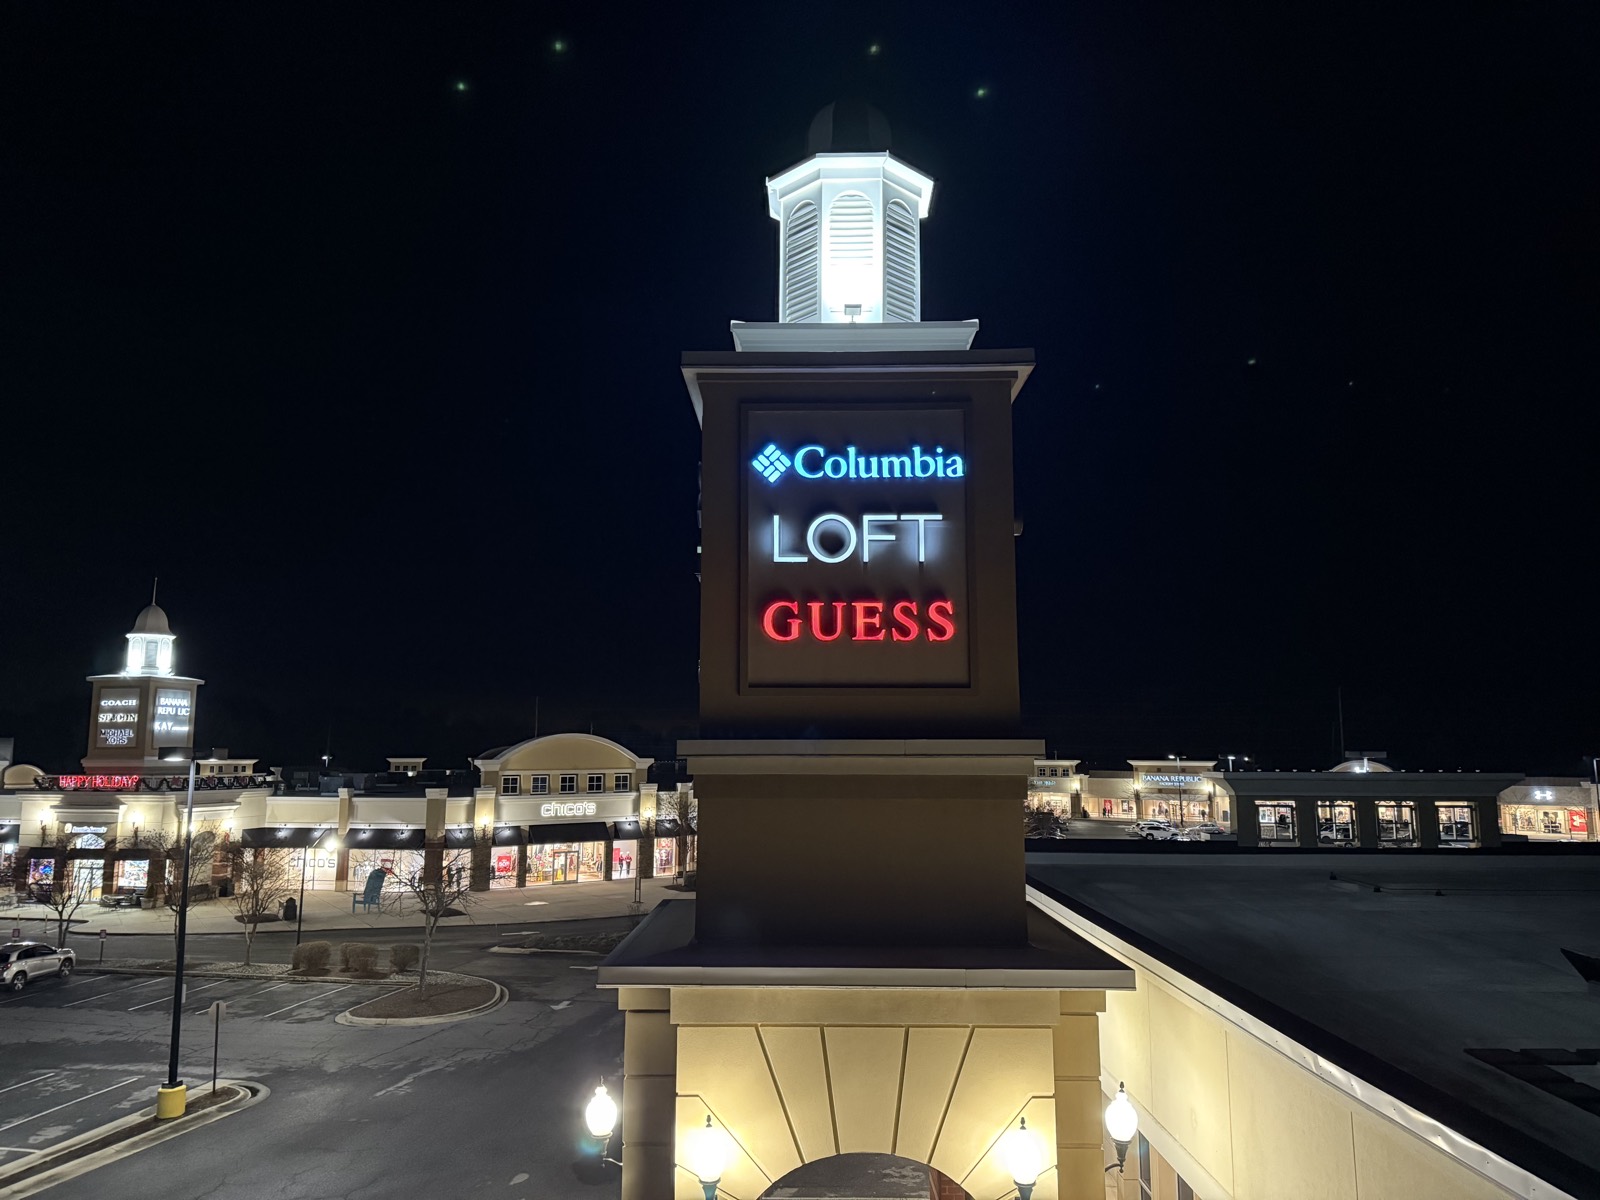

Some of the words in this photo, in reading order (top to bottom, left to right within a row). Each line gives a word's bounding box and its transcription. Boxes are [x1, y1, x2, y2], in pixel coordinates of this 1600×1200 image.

[794, 446, 965, 479] Columbia
[773, 513, 943, 563] LOFT
[762, 600, 956, 642] GUESS
[160, 697, 188, 707] BANANA
[157, 707, 190, 715] REPULIC
[154, 722, 174, 731] KAY
[100, 729, 133, 737] MICHAEL
[106, 736, 128, 745] KORS
[59, 776, 91, 787] HAPPY
[1170, 775, 1202, 783] REPUBLIC
[542, 801, 596, 816] chico's
